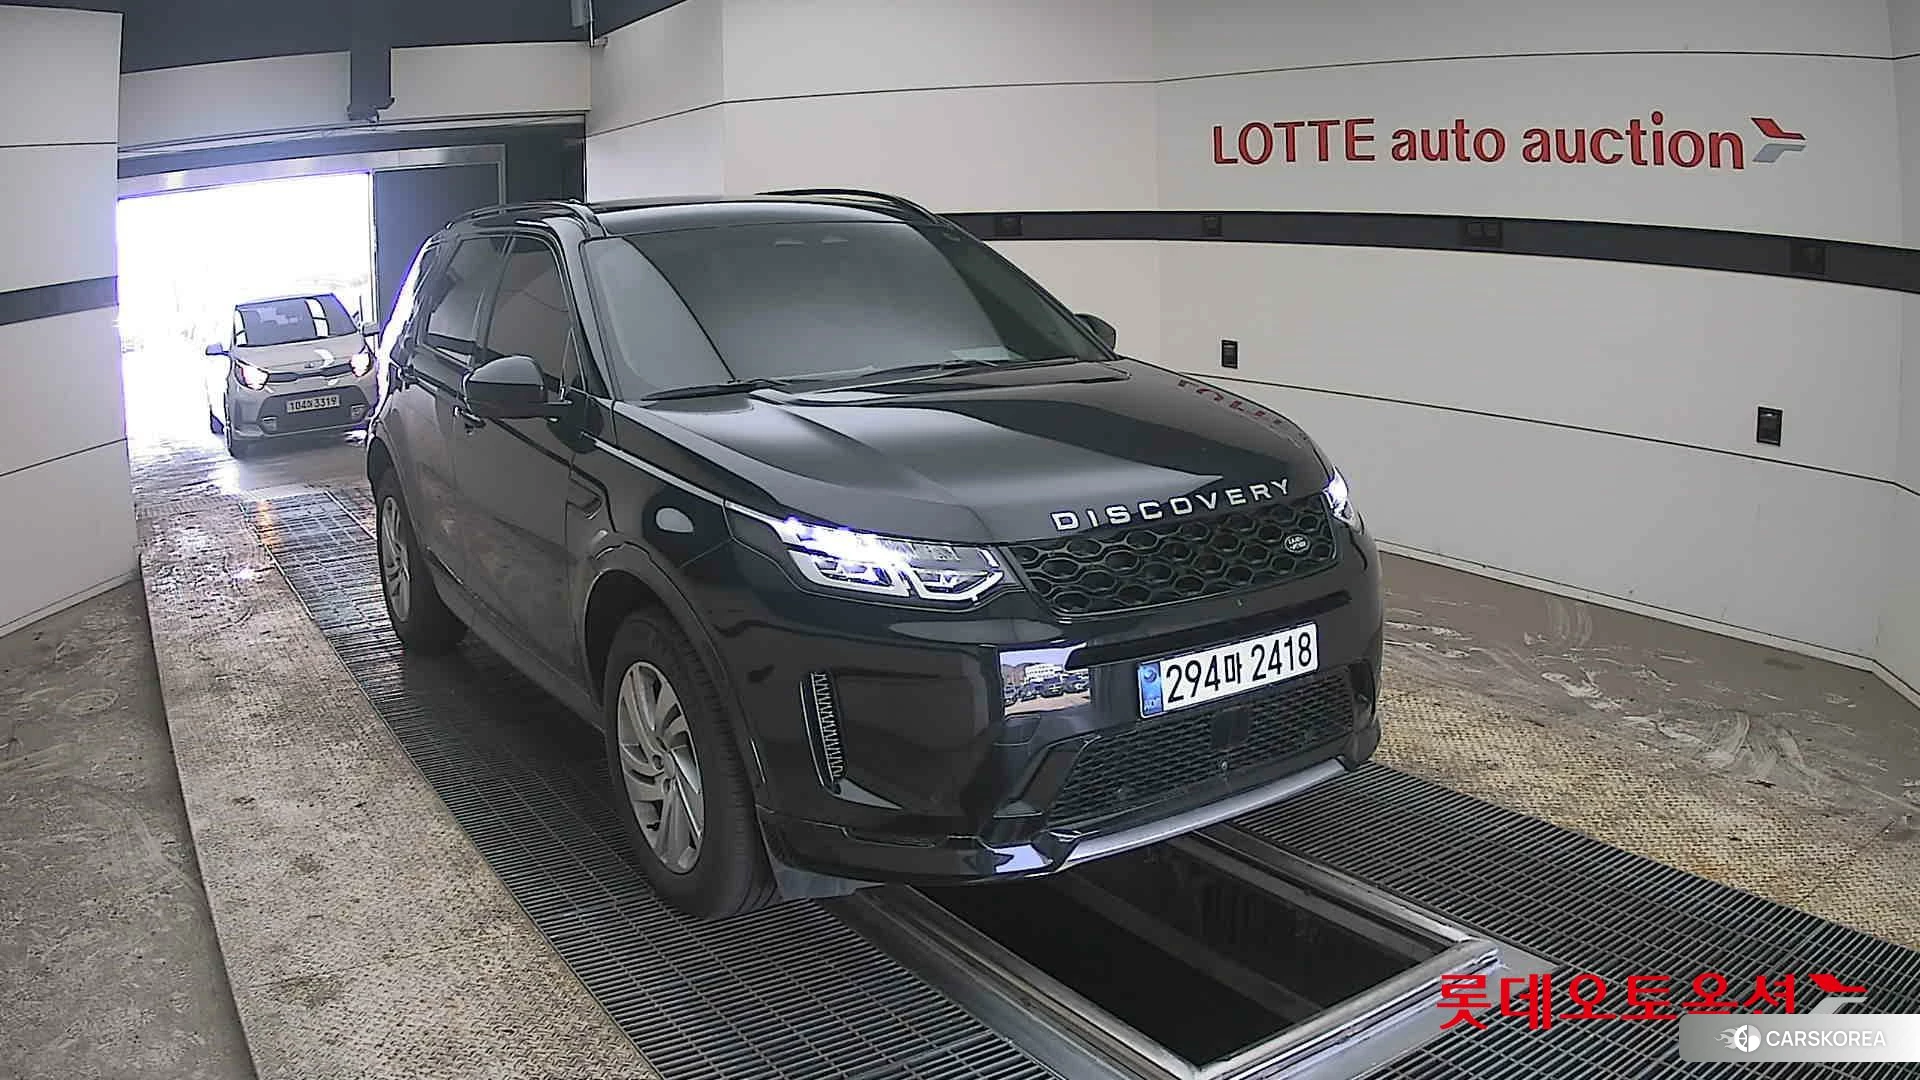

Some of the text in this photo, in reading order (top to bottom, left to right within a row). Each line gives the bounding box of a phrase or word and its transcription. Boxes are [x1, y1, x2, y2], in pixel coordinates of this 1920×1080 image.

[1213, 111, 1745, 170] LOTTE auto auction
[1051, 478, 1289, 531] DISCOVERY
[1166, 631, 1312, 703] 294마 2418
